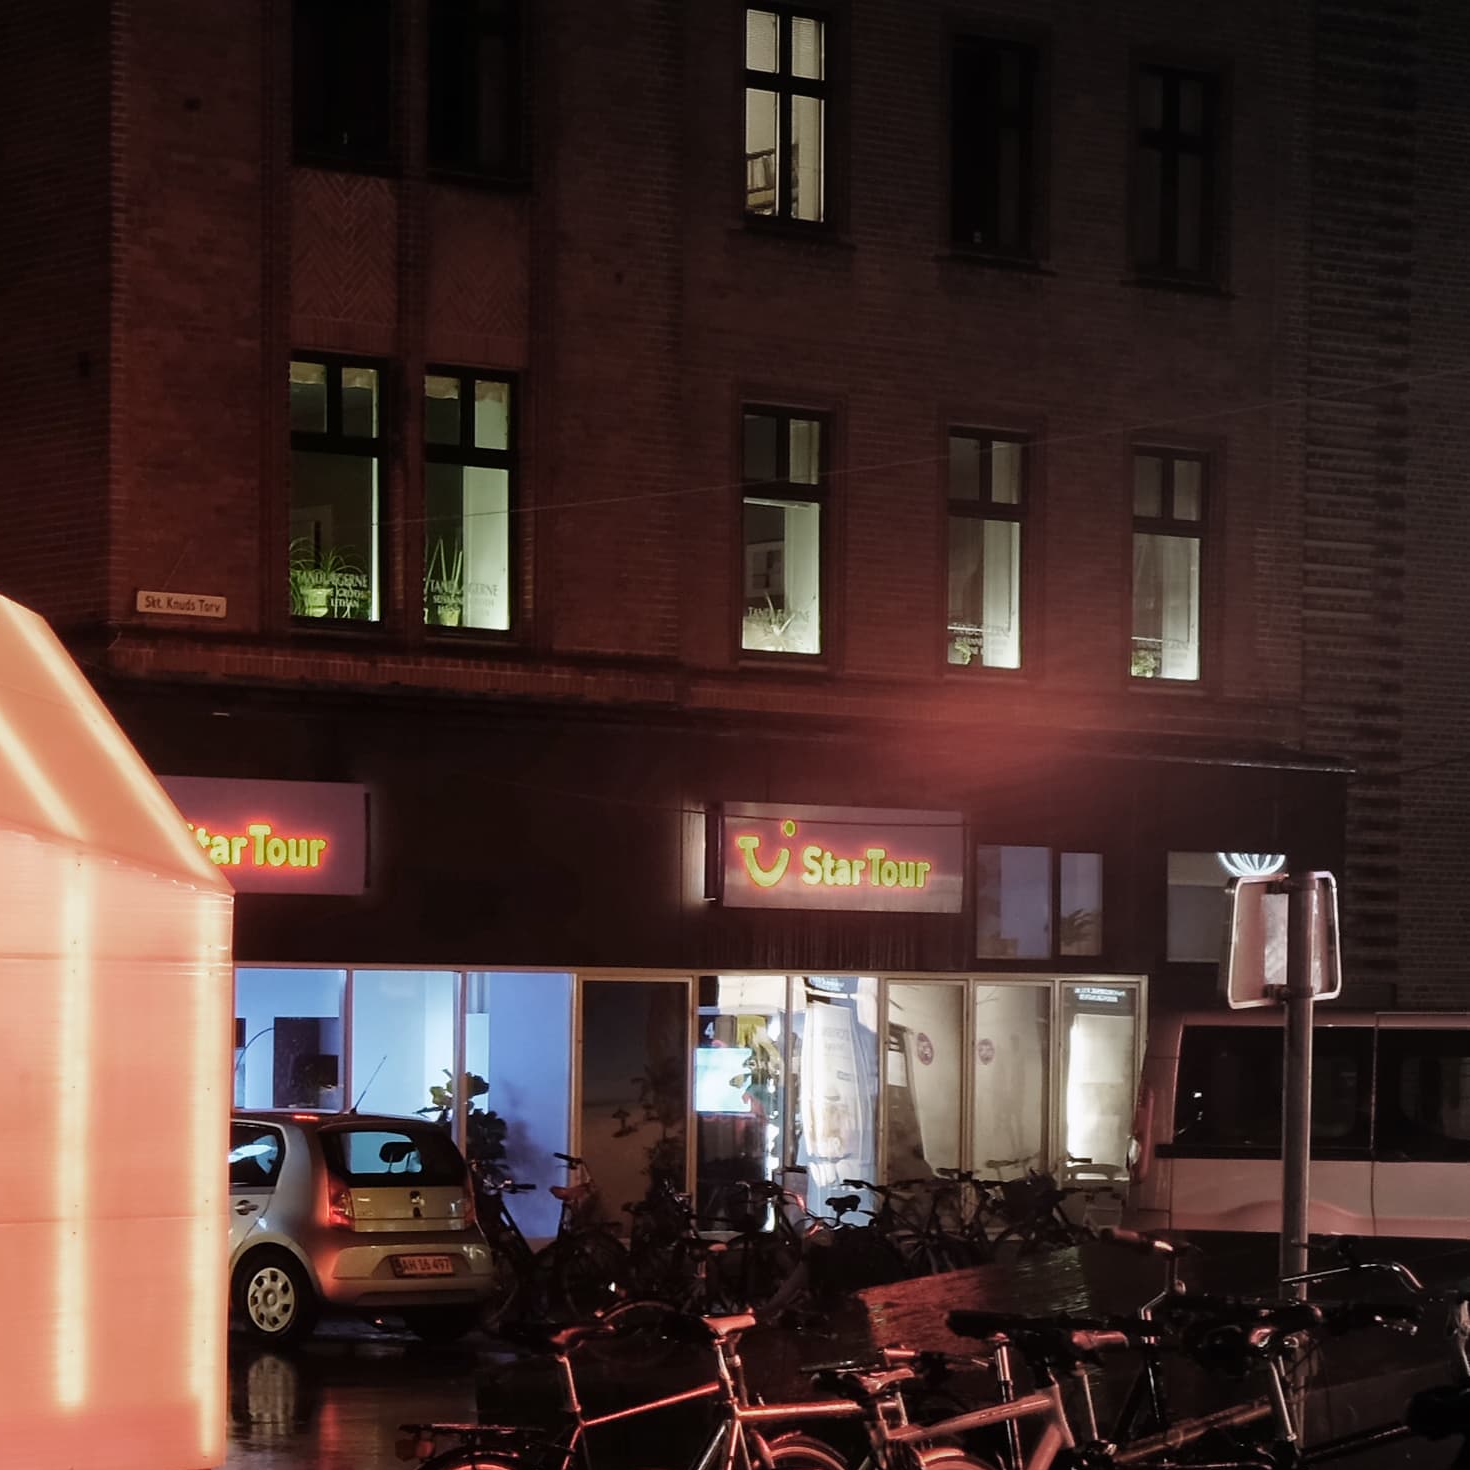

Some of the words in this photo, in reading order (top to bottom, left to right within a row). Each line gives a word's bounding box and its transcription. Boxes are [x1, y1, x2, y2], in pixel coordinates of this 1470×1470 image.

[187, 823, 248, 864] tar
[248, 824, 326, 867] Tour
[802, 846, 866, 886] Star
[866, 848, 931, 888] Tour
